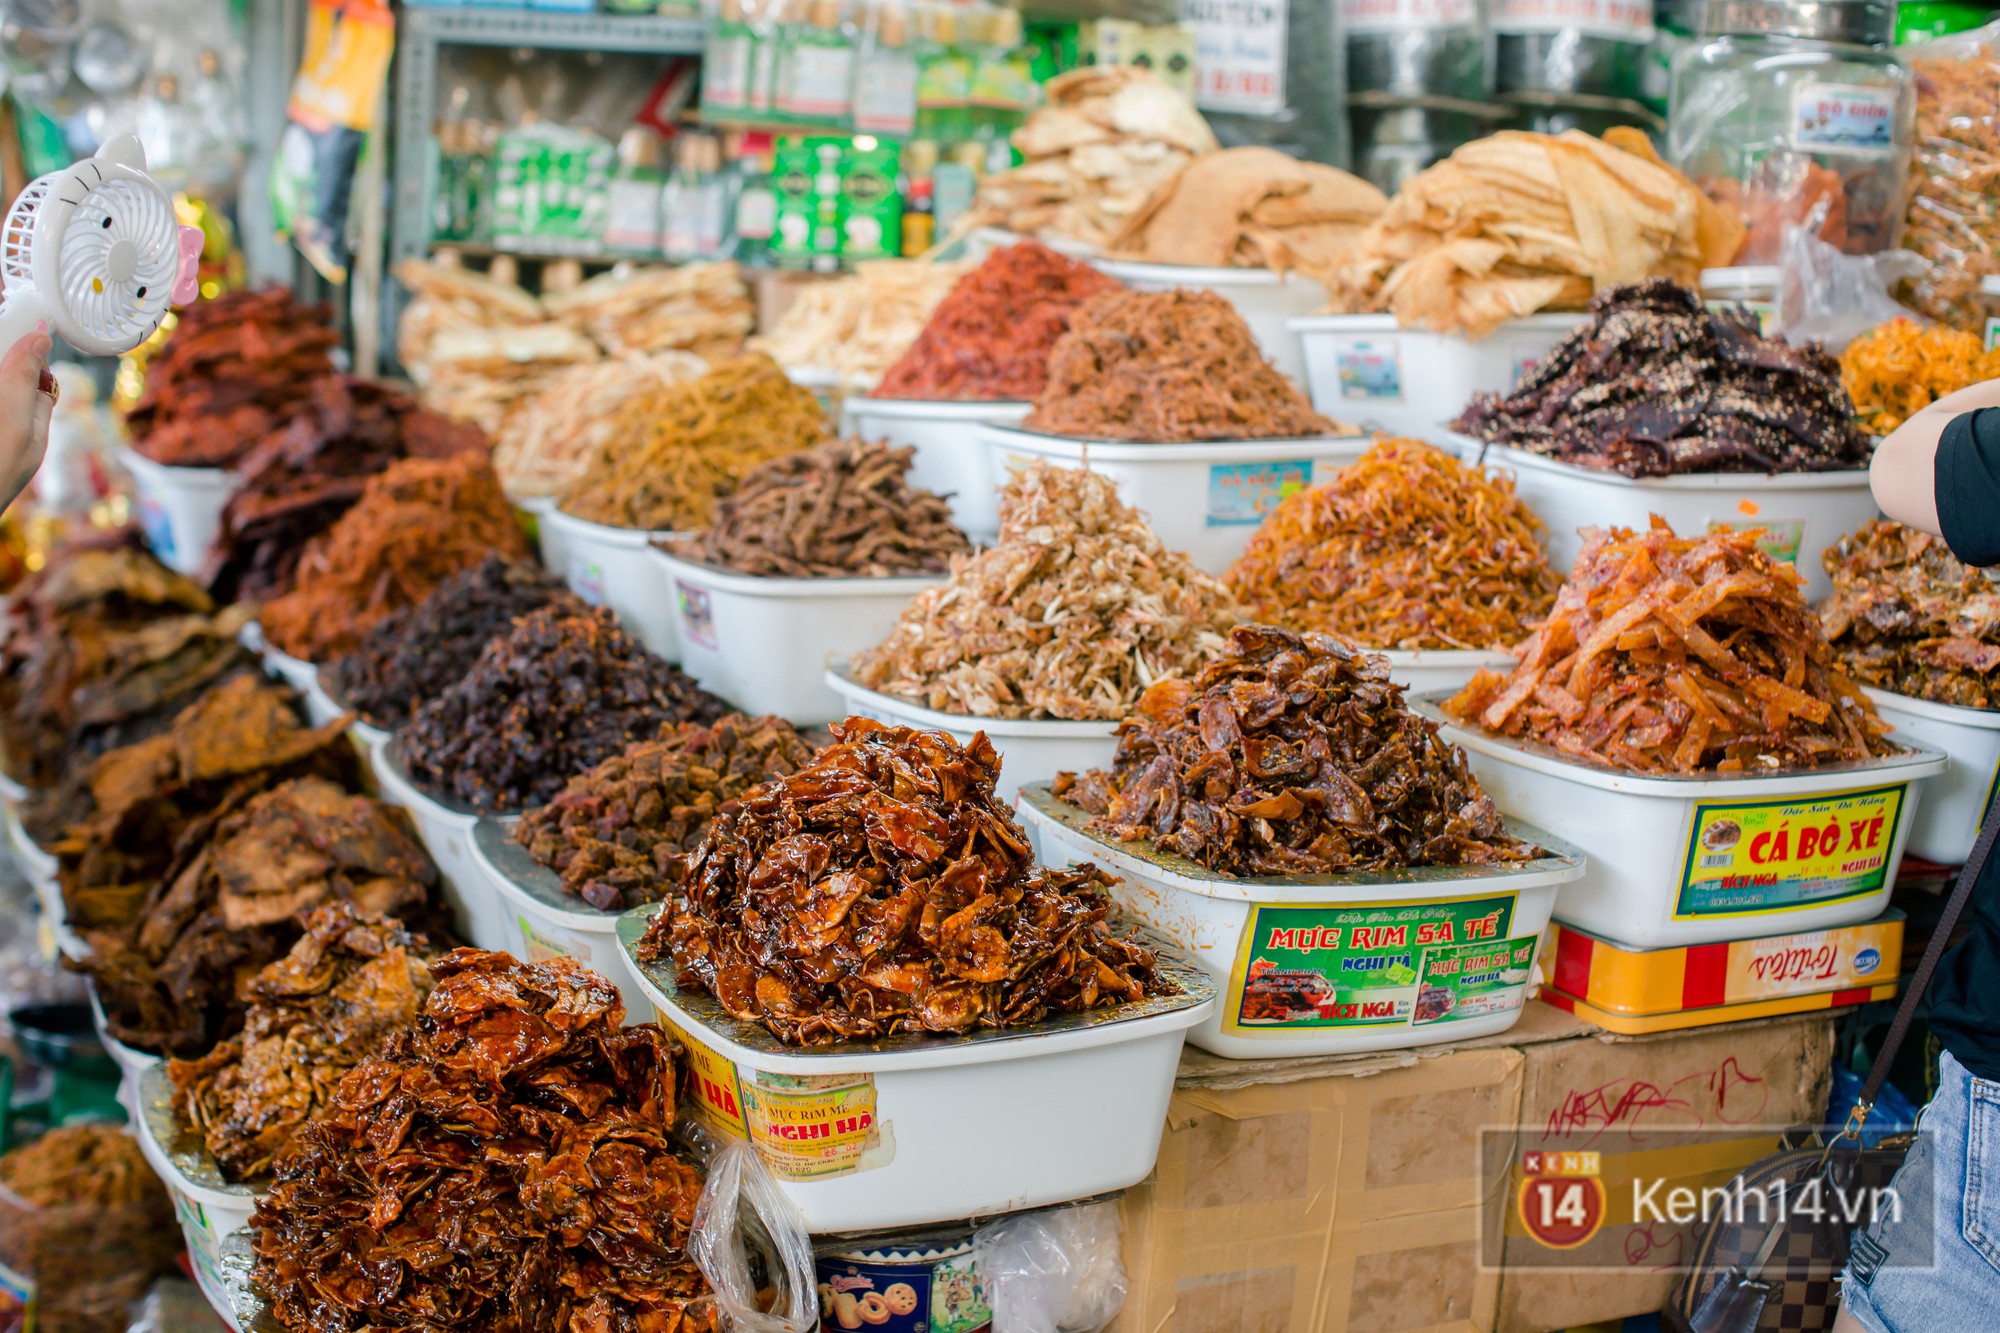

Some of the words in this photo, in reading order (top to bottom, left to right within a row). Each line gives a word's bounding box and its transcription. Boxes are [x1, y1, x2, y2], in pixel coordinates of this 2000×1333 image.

[1749, 819, 1789, 865] CÁ
[1845, 806, 1885, 853] XÉ
[1722, 873, 1752, 890] BÍCH
[1752, 872, 1778, 887] NGA
[1267, 925, 1341, 954] MỰC
[1349, 925, 1409, 951] RIM
[1415, 921, 1455, 946] SA
[1464, 908, 1505, 940] TẾ
[1342, 958, 1386, 972] NGHI
[1428, 957, 1461, 977] MỰC
[1463, 956, 1490, 972] RIM
[1492, 952, 1511, 967] SA
[1460, 973, 1486, 985] NGHI
[1321, 1001, 1359, 1020] BÍCH
[1360, 1001, 1395, 1017] NGA
[704, 1077, 740, 1119] HÀ
[767, 1121, 831, 1141] NGHI
[836, 1110, 873, 1135] HÀ
[769, 1107, 797, 1122] MỰC
